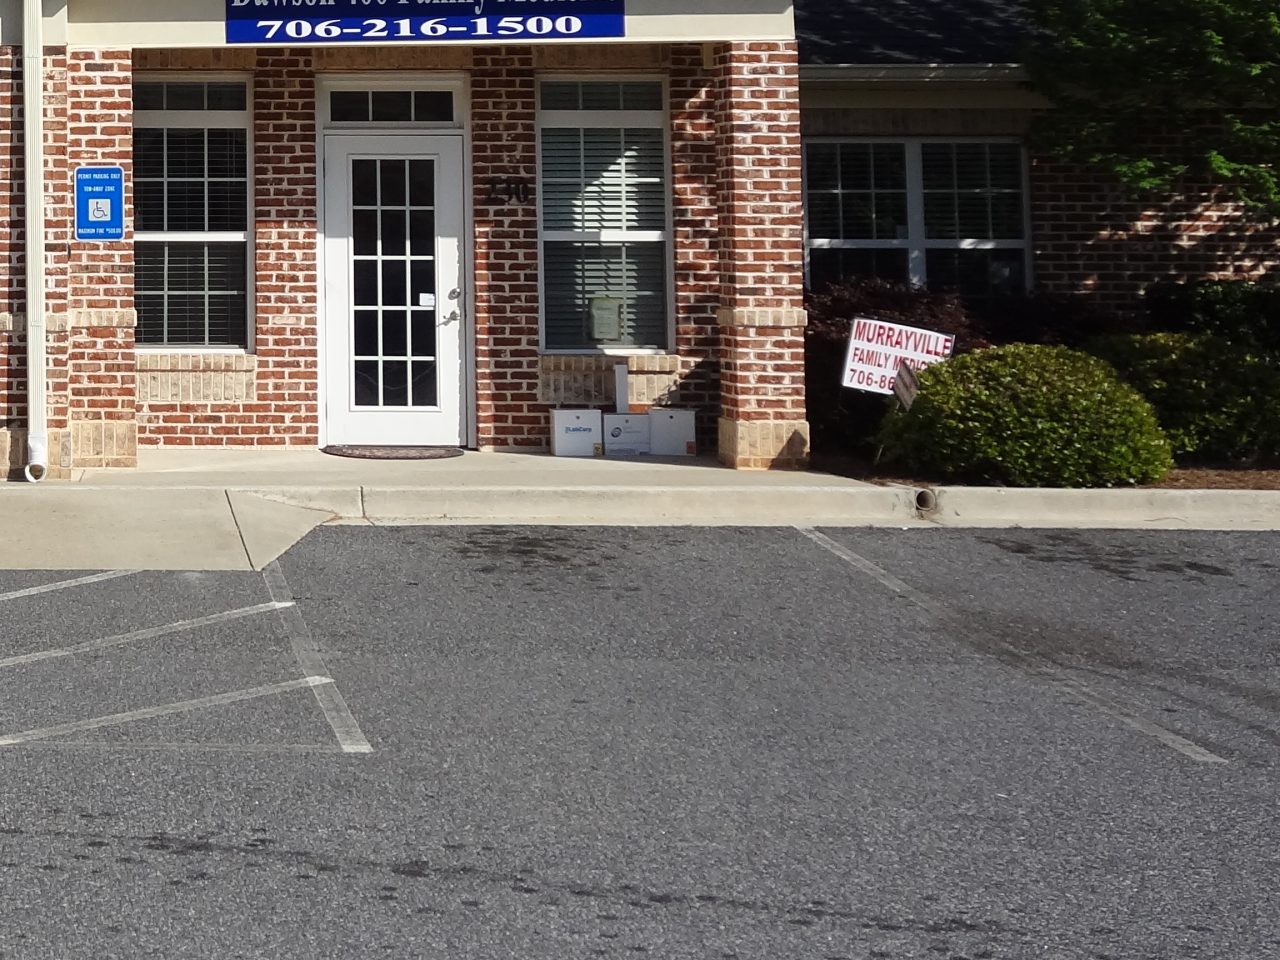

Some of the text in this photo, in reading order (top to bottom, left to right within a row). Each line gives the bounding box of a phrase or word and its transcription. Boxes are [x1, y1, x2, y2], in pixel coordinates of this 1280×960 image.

[256, 15, 583, 39] 706-216-1500
[854, 321, 952, 356] MURRAYVILLE
[852, 347, 891, 369] FAMILY
